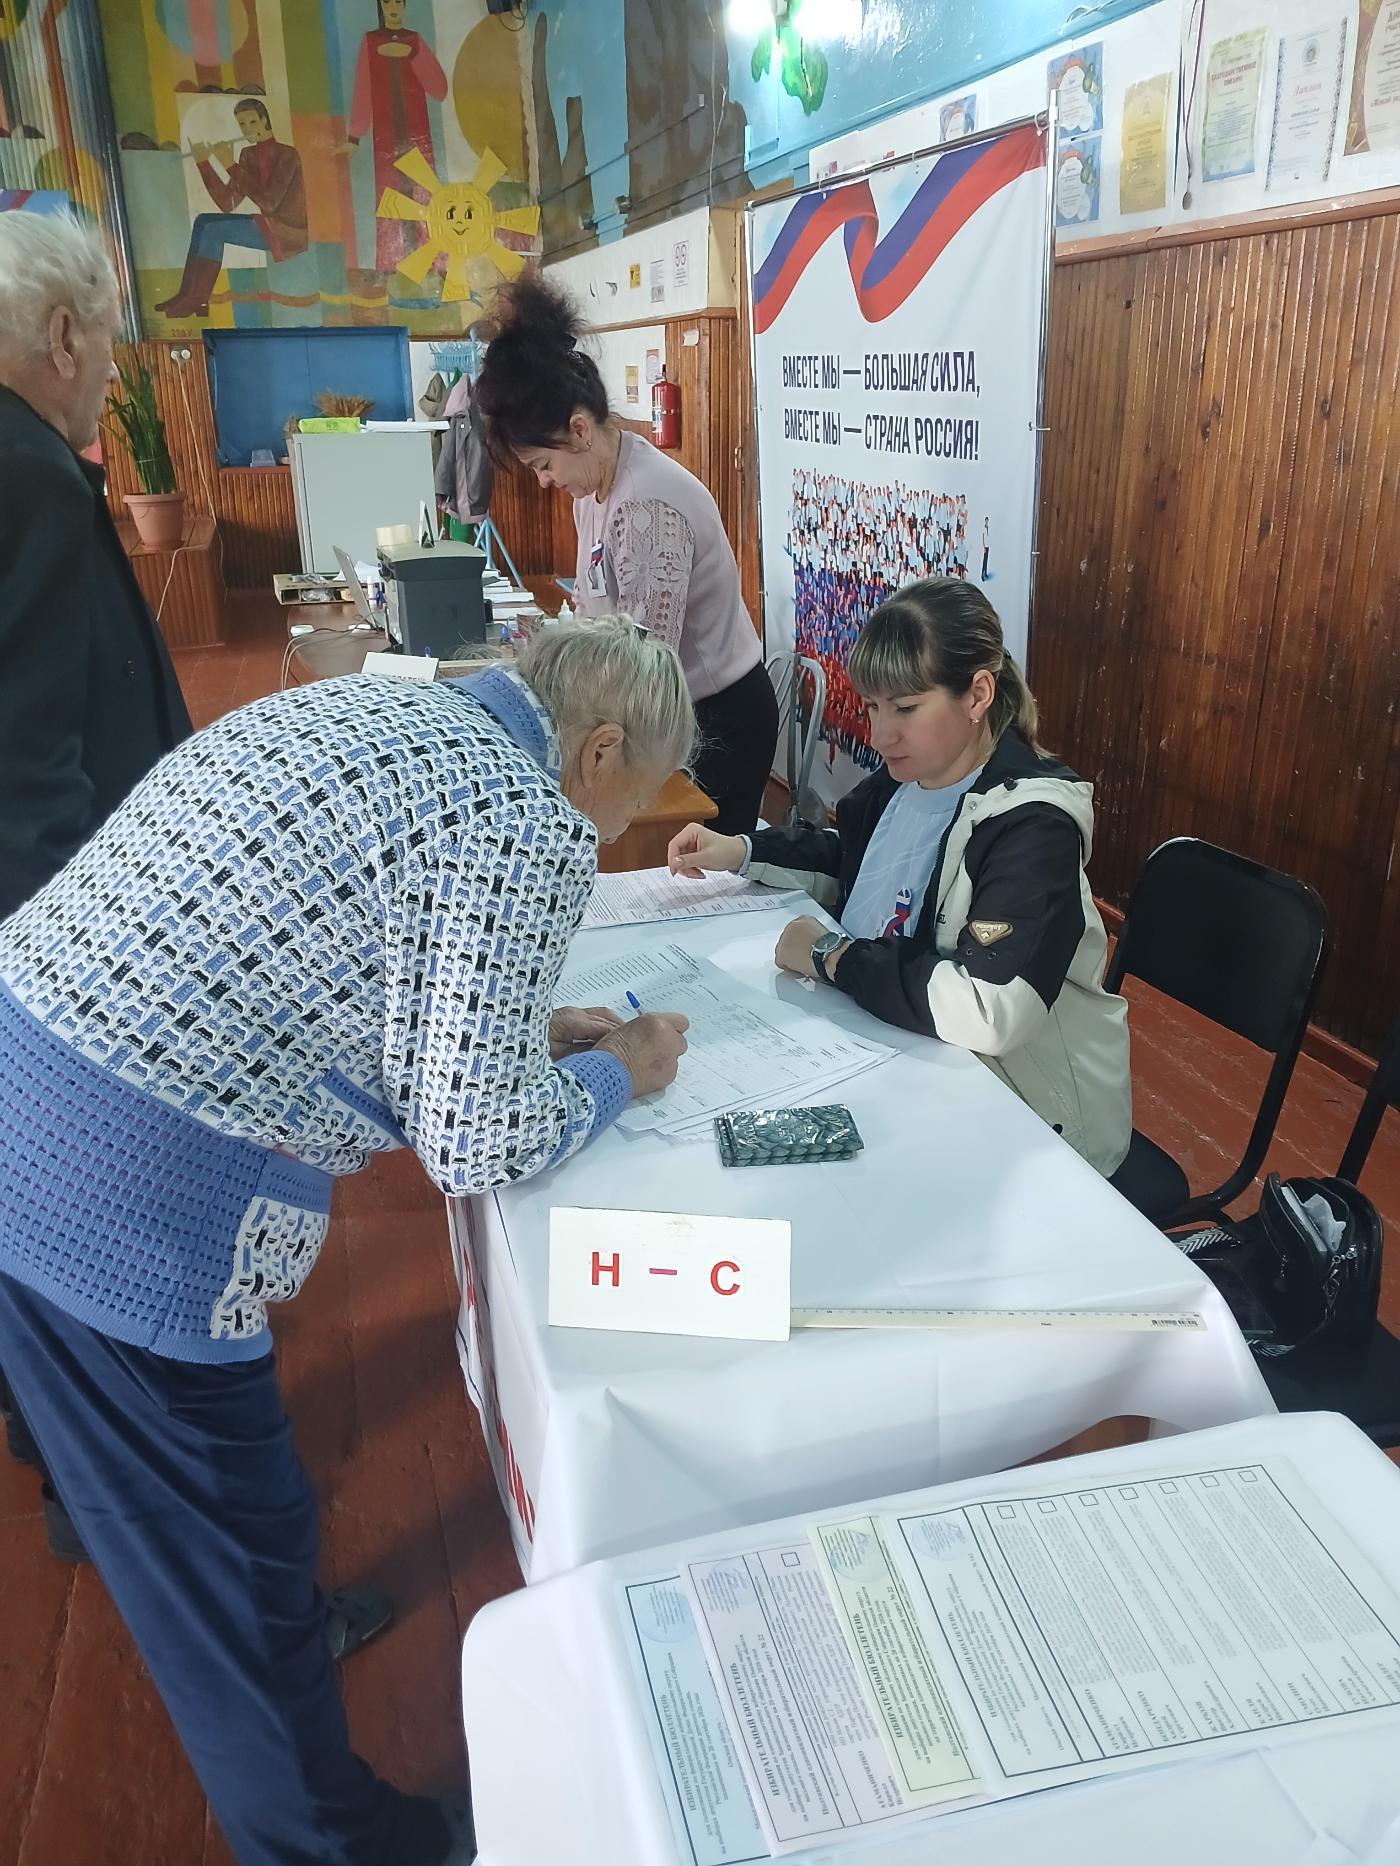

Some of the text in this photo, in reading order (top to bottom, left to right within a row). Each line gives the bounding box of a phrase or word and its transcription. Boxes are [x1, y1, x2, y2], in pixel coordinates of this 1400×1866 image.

[782, 355, 819, 389] ВМЕСТЕ
[821, 355, 840, 389] МЫ
[864, 353, 929, 391] БОЛЬШАЯ
[930, 351, 980, 398] СИЛА,
[784, 408, 820, 443] ВМЕСТЕ
[822, 412, 841, 446] МЫ
[864, 414, 911, 454] СТРАНА
[915, 417, 979, 461] РОССИЯ!
[591, 1252, 620, 1288] Н
[709, 1260, 741, 1296] С
[851, 1612, 903, 1738] ИЗБИРАТЕЛЬНЫЙ БЮЛЛЕТЕНЬ
